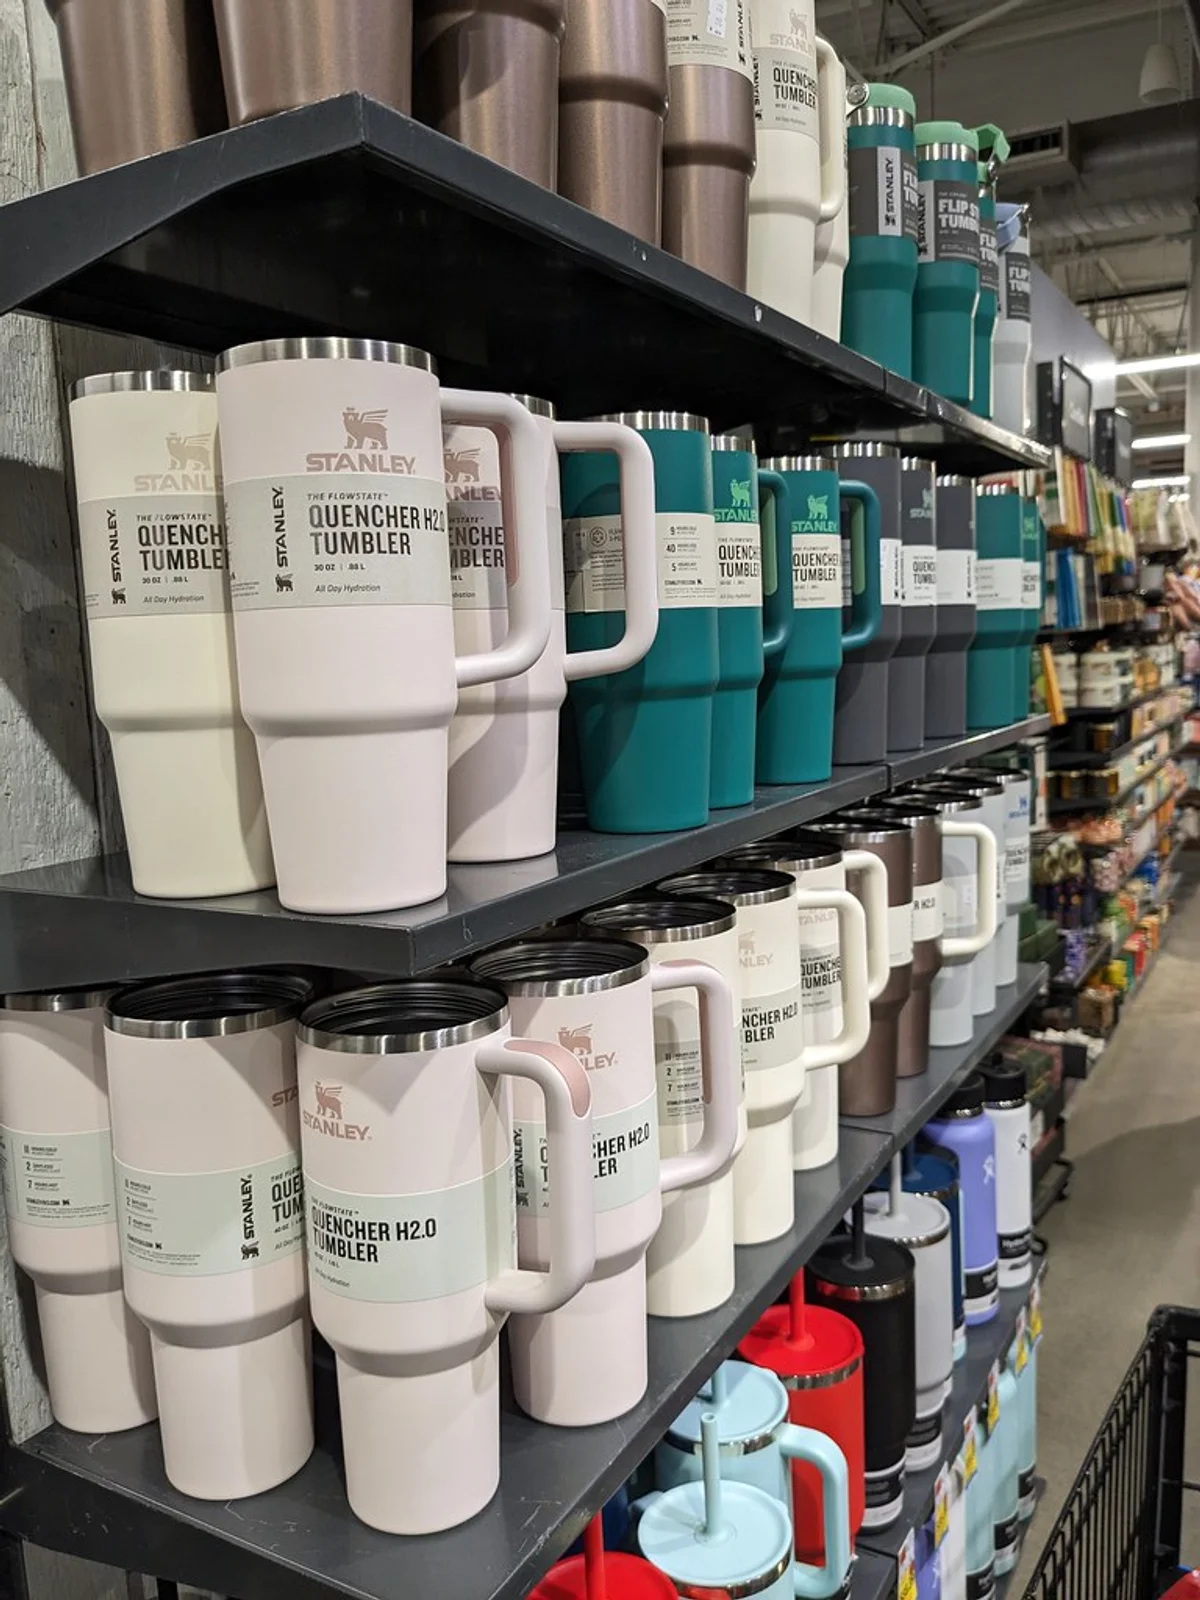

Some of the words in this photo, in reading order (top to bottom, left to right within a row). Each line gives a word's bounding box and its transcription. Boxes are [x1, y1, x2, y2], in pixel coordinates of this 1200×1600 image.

[886, 158, 895, 213] STANLEY
[938, 199, 968, 213] FLIP
[938, 214, 980, 234] TUMB
[306, 453, 416, 475] STANLEY
[134, 474, 223, 492] STANLE
[307, 493, 325, 501] THE
[308, 503, 420, 530] QUENCHER
[714, 509, 758, 522] STANLE
[272, 486, 289, 568] STANLEY
[106, 509, 122, 583] STANLEY
[309, 532, 412, 556] TUMBLER
[666, 544, 676, 553] 40
[325, 563, 335, 571] OZ
[152, 576, 161, 584] OZ
[315, 584, 325, 593] All
[326, 584, 342, 594] Day
[343, 584, 381, 593] Hydration
[154, 595, 168, 604] Day
[169, 594, 205, 603] Hydration
[666, 1067, 672, 1076] 2
[303, 1110, 372, 1141] STANLEY
[26, 1161, 31, 1171] 2
[513, 1129, 525, 1188] STANLEY
[240, 1173, 255, 1240] STANLEY
[311, 1205, 390, 1241] QUENCHER
[396, 1218, 437, 1241] H2.0
[312, 1226, 379, 1263] TUMBLER
